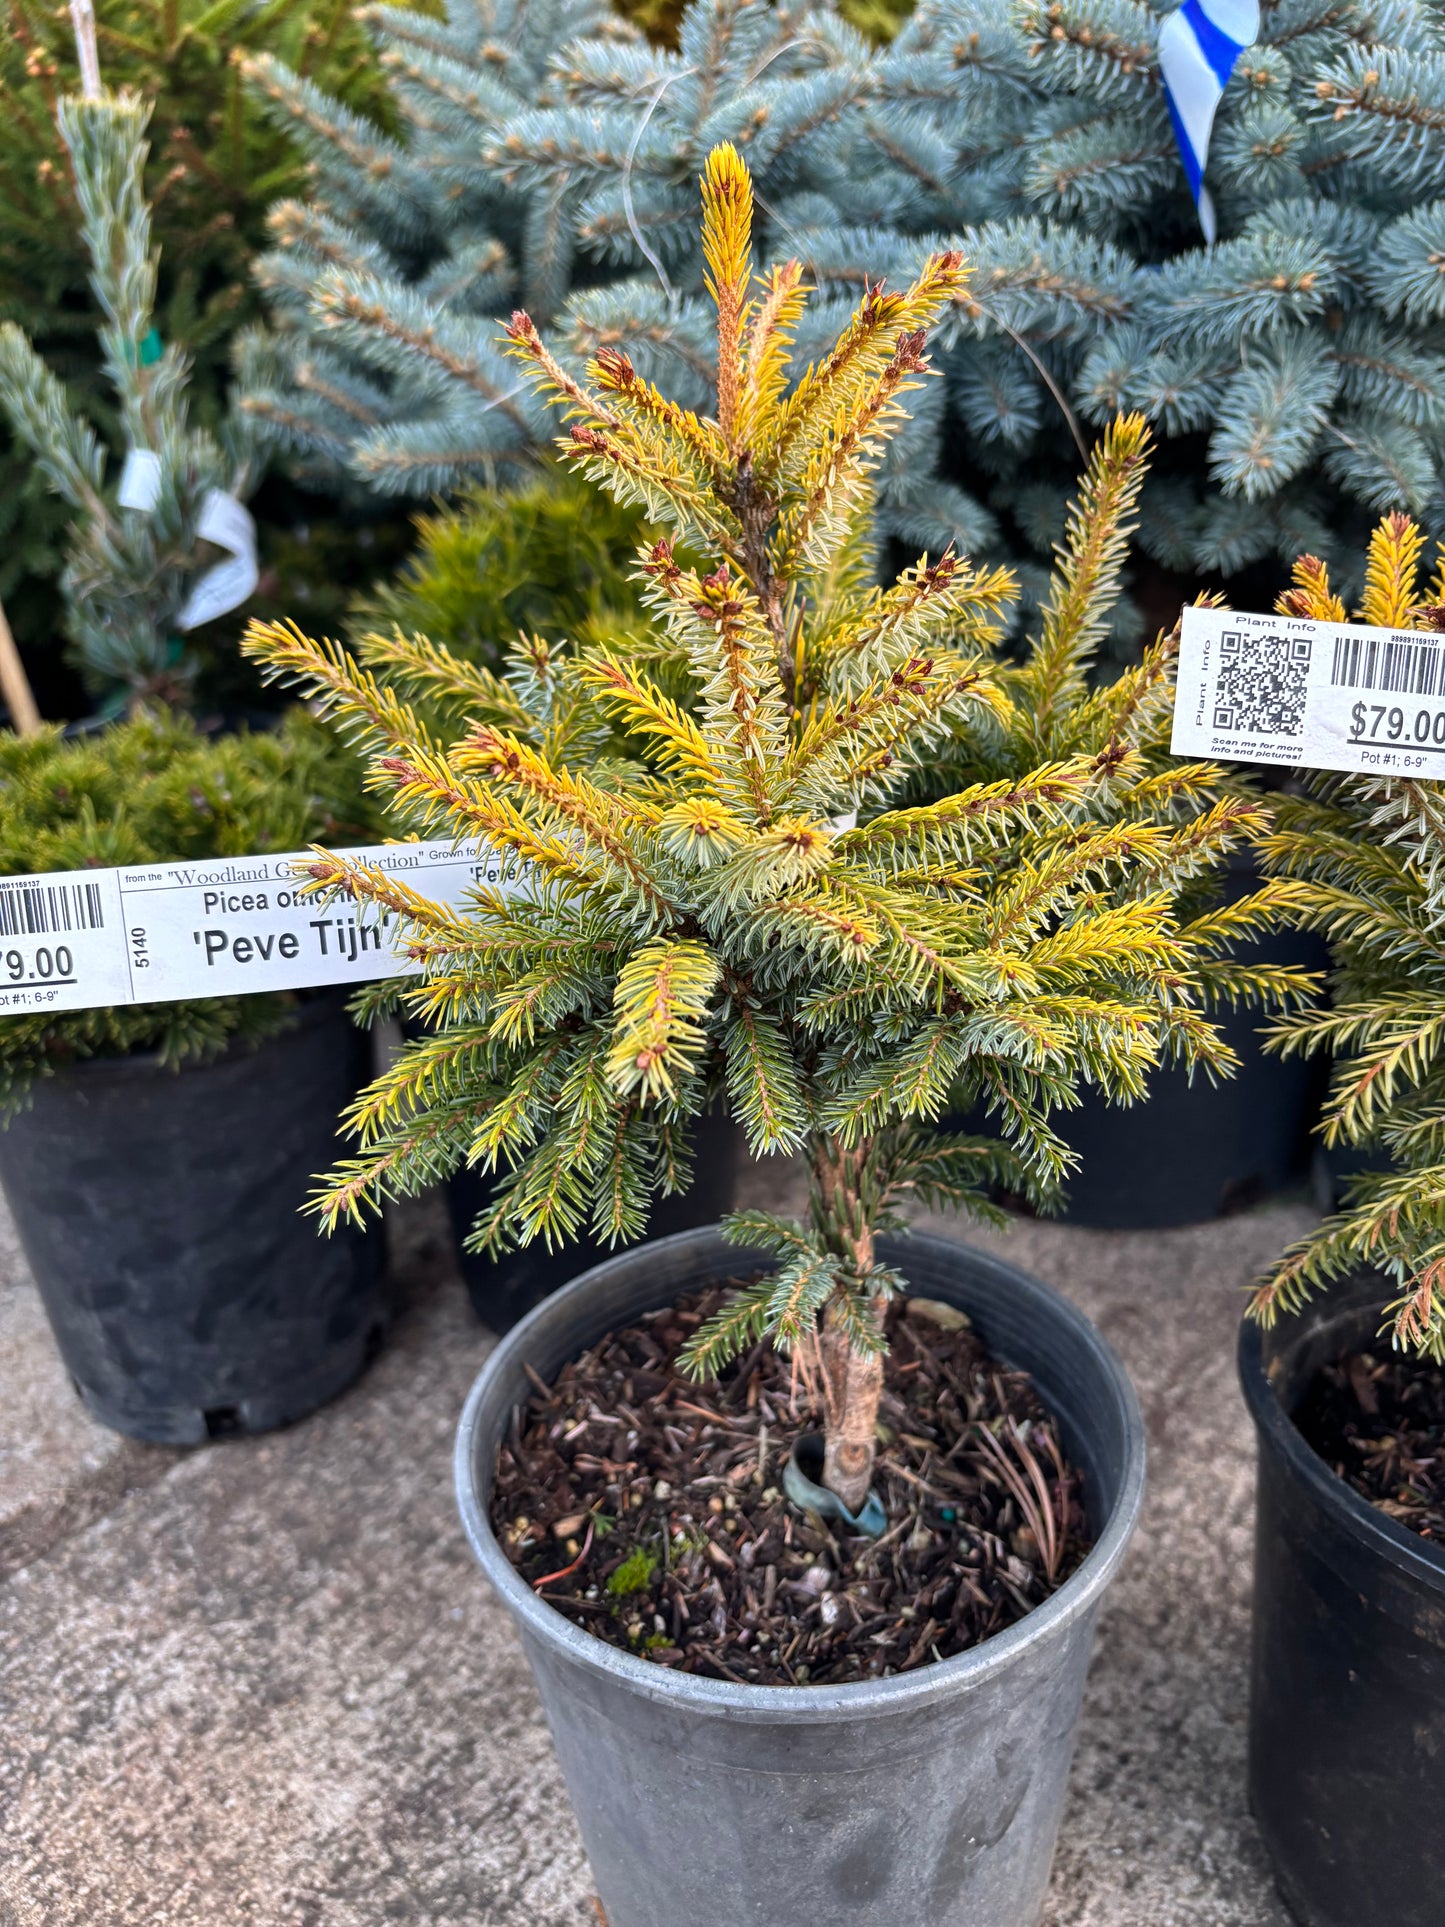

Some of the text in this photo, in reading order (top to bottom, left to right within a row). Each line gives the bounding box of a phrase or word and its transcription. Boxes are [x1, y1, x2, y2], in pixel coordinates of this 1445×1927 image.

[1235, 616, 1316, 632] Plant Info
[1195, 639, 1211, 726] Plant Info
[1349, 700, 1445, 745] $79.00
[1210, 745, 1231, 754] info
[1254, 750, 1302, 761] pictures!
[1211, 737, 1238, 746] Scan
[1259, 742, 1275, 750] for
[1360, 751, 1428, 768] Pot #1; 6-9"
[125, 874, 146, 883] from
[148, 873, 162, 881] the
[168, 863, 268, 886] "Woodland
[341, 851, 424, 872] ollection"
[429, 849, 464, 860] Grown
[466, 847, 478, 857] fo
[0, 880, 40, 890] 891159137
[203, 891, 269, 915] Picea
[131, 927, 150, 968] 5140
[193, 915, 389, 966] 'Peve Tijn'
[0, 945, 74, 981] 9.00
[13, 993, 31, 1005] #1;
[35, 990, 58, 1003] 6-9"
